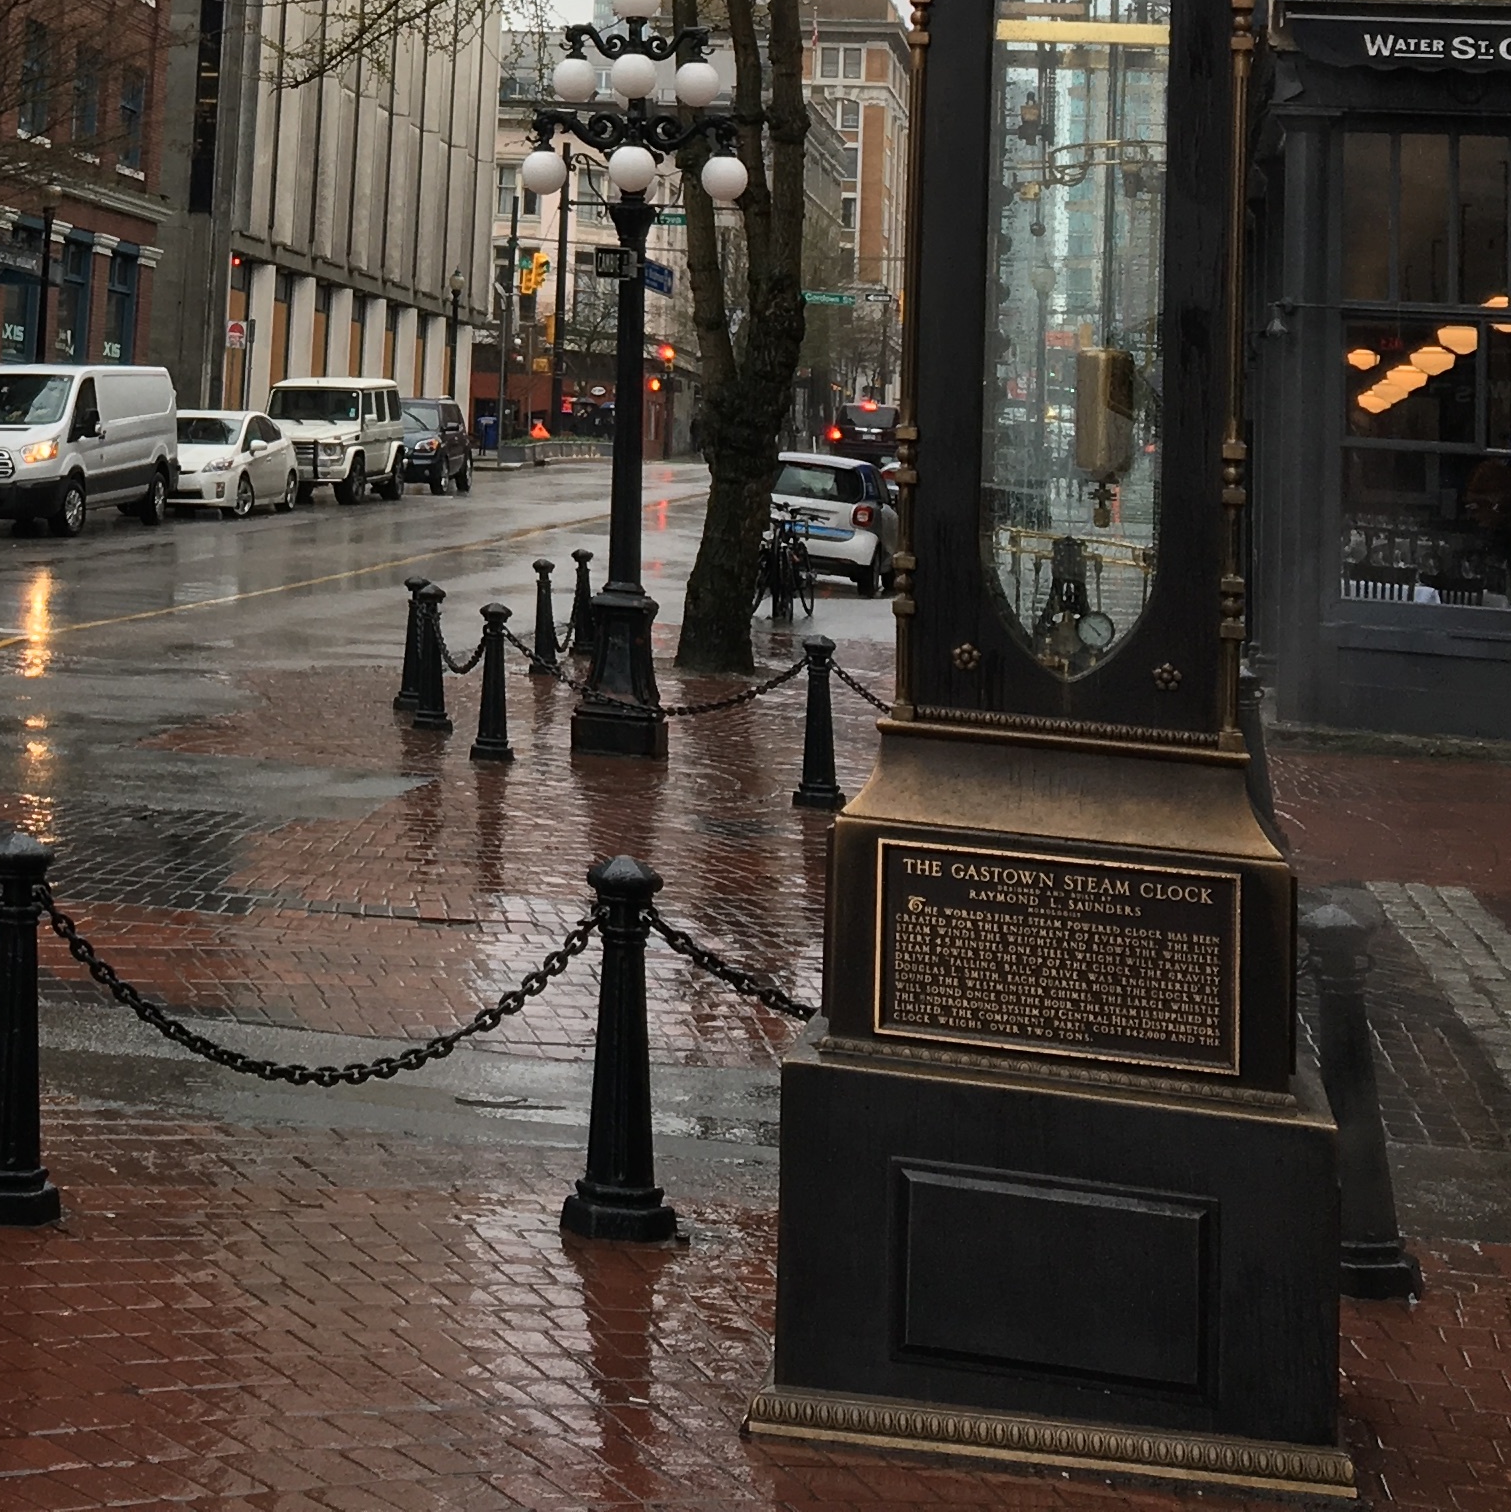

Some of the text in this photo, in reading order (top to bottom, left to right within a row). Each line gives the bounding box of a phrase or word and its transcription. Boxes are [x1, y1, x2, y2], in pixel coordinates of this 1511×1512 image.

[102, 341, 121, 358] XIS
[902, 857, 1214, 905] THE GASTOWN STEAM CLOCK
[1045, 889, 1064, 897] AND
[907, 894, 938, 915] THE
[994, 912, 1023, 925] FIRST
[1027, 915, 1062, 929] STEAM
[1067, 920, 1120, 935] POWERED
[1124, 926, 1162, 939] CLOCK
[1167, 930, 1188, 942] HAS
[1192, 933, 1220, 946] BEEN
[968, 888, 1039, 906] RAYMOND
[1068, 899, 1142, 917] SAUNDERS
[895, 912, 946, 926] CREATED
[951, 918, 973, 929] FOR
[977, 921, 999, 932] THE
[1002, 924, 1069, 940] ENJOYMENT
[1074, 932, 1088, 942] OF
[1167, 942, 1189, 952] THE
[1194, 944, 1219, 956] LIVE
[895, 922, 1157, 959] STEAM WINDS THE WEIGHTS AND BLOWS THE
[895, 931, 931, 944] EVERY
[955, 938, 1003, 952] MINUTES
[1008, 944, 1031, 955] ONE
[1036, 947, 1069, 959] STEEL
[1074, 951, 1120, 965] WEIGHT
[1125, 956, 1153, 968] WILL
[1158, 960, 1200, 973] TRAVEL
[1205, 965, 1220, 975] BY
[894, 941, 1220, 986] STEAM POWER TO THE TOP OF THE THE GRAVITY
[894, 950, 1219, 995] DRIVEN DRIVE WAS BY
[894, 970, 1219, 1015] SOUND THE WESTMINSTER THE LARGE WHISTLE
[894, 981, 1220, 1026] WILL SOUND ONCE ON THE THE STEAM IS SUPPLIED BY
[894, 991, 915, 1002] THE
[1001, 1003, 1040, 1016] SYSTEM
[1042, 1007, 1054, 1018] OF
[1113, 1015, 1139, 1027] HEAT
[1007, 972, 1035, 985] EACH
[1038, 976, 1088, 991] QUARTER
[1092, 982, 1123, 995] HOUR
[1126, 985, 1146, 997] THE
[1150, 988, 1189, 1002] CLOCK
[1192, 993, 1220, 1006] WILL
[893, 1010, 930, 1024] CLOCK
[937, 1016, 982, 1030] WEIGHS
[989, 1022, 1020, 1034] OVER
[1026, 1026, 1053, 1038] TWO
[951, 1007, 972, 1018] THE
[977, 1010, 1045, 1027] COMPONENT
[1092, 1023, 1122, 1035] COST
[1170, 1032, 1195, 1044] AND
[1198, 1035, 1221, 1047] THE
